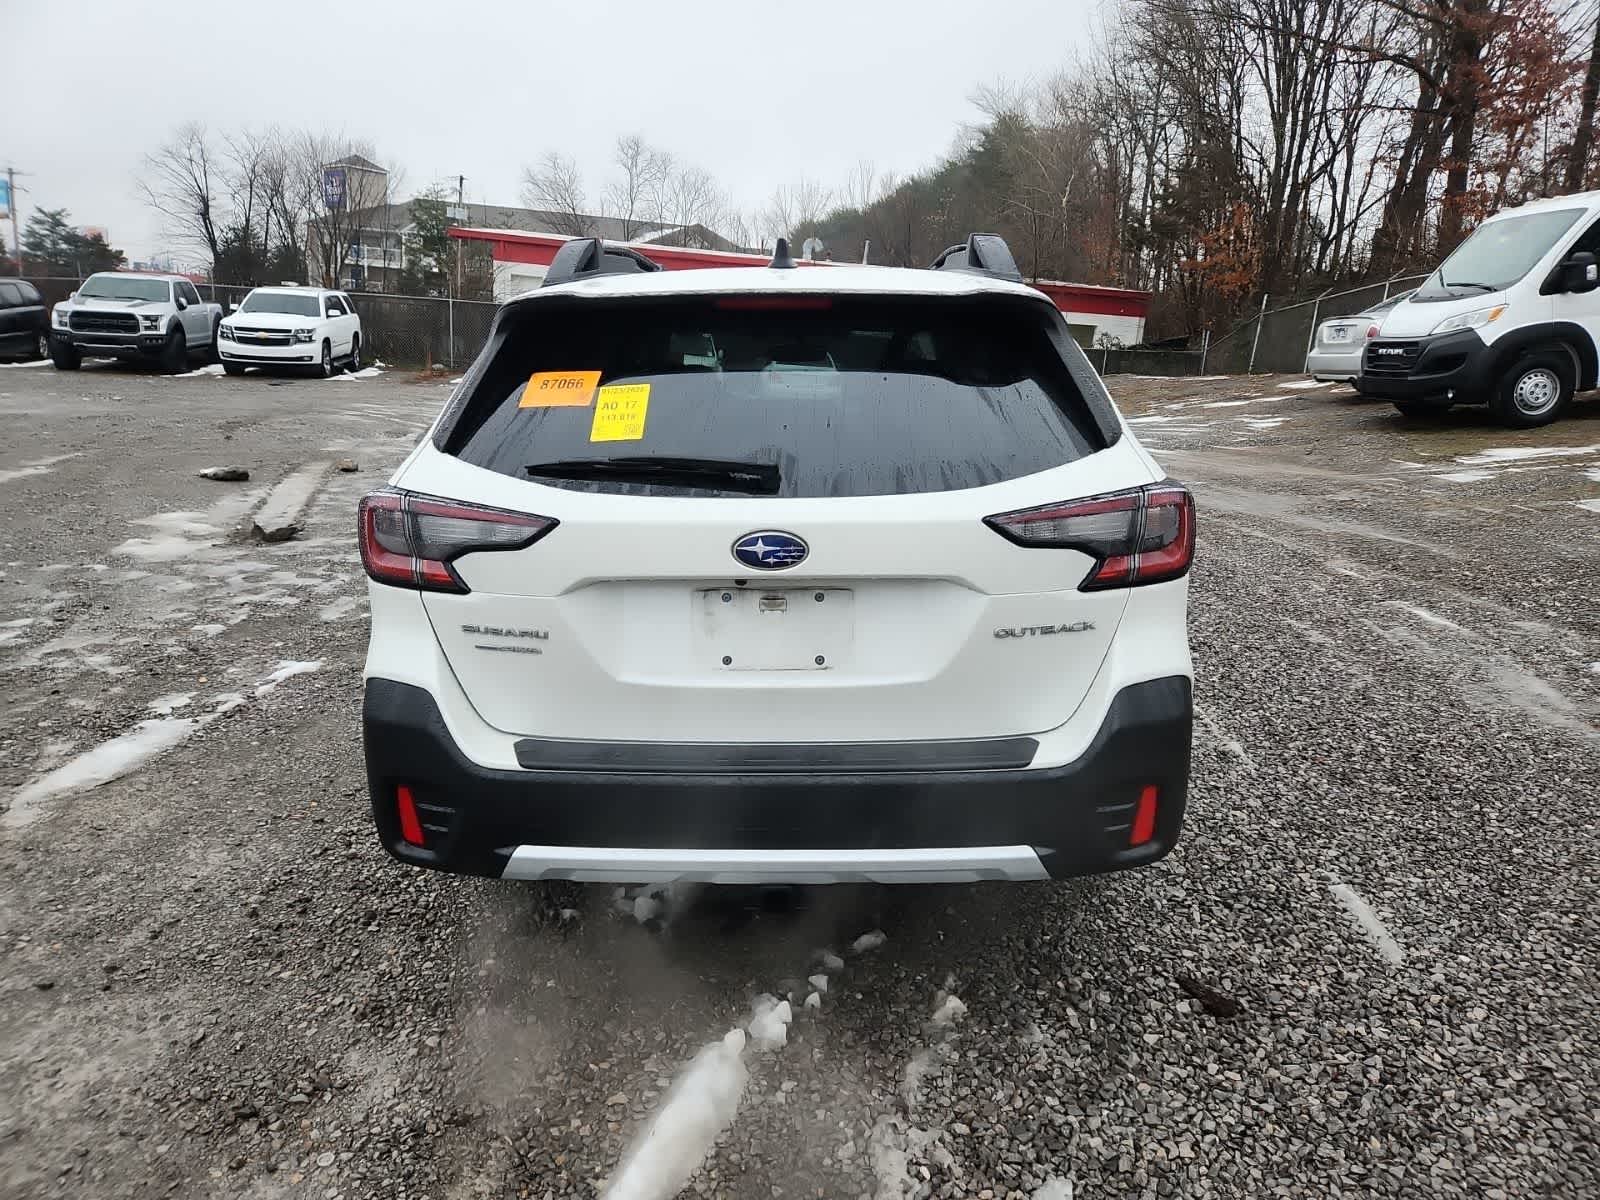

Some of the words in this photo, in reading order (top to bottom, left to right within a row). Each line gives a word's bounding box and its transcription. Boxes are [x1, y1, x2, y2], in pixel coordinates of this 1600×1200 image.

[1378, 348, 1404, 356] RAM
[540, 378, 585, 391] 87066
[461, 623, 549, 641] SUBARU
[993, 620, 1097, 640] OUTBACK
